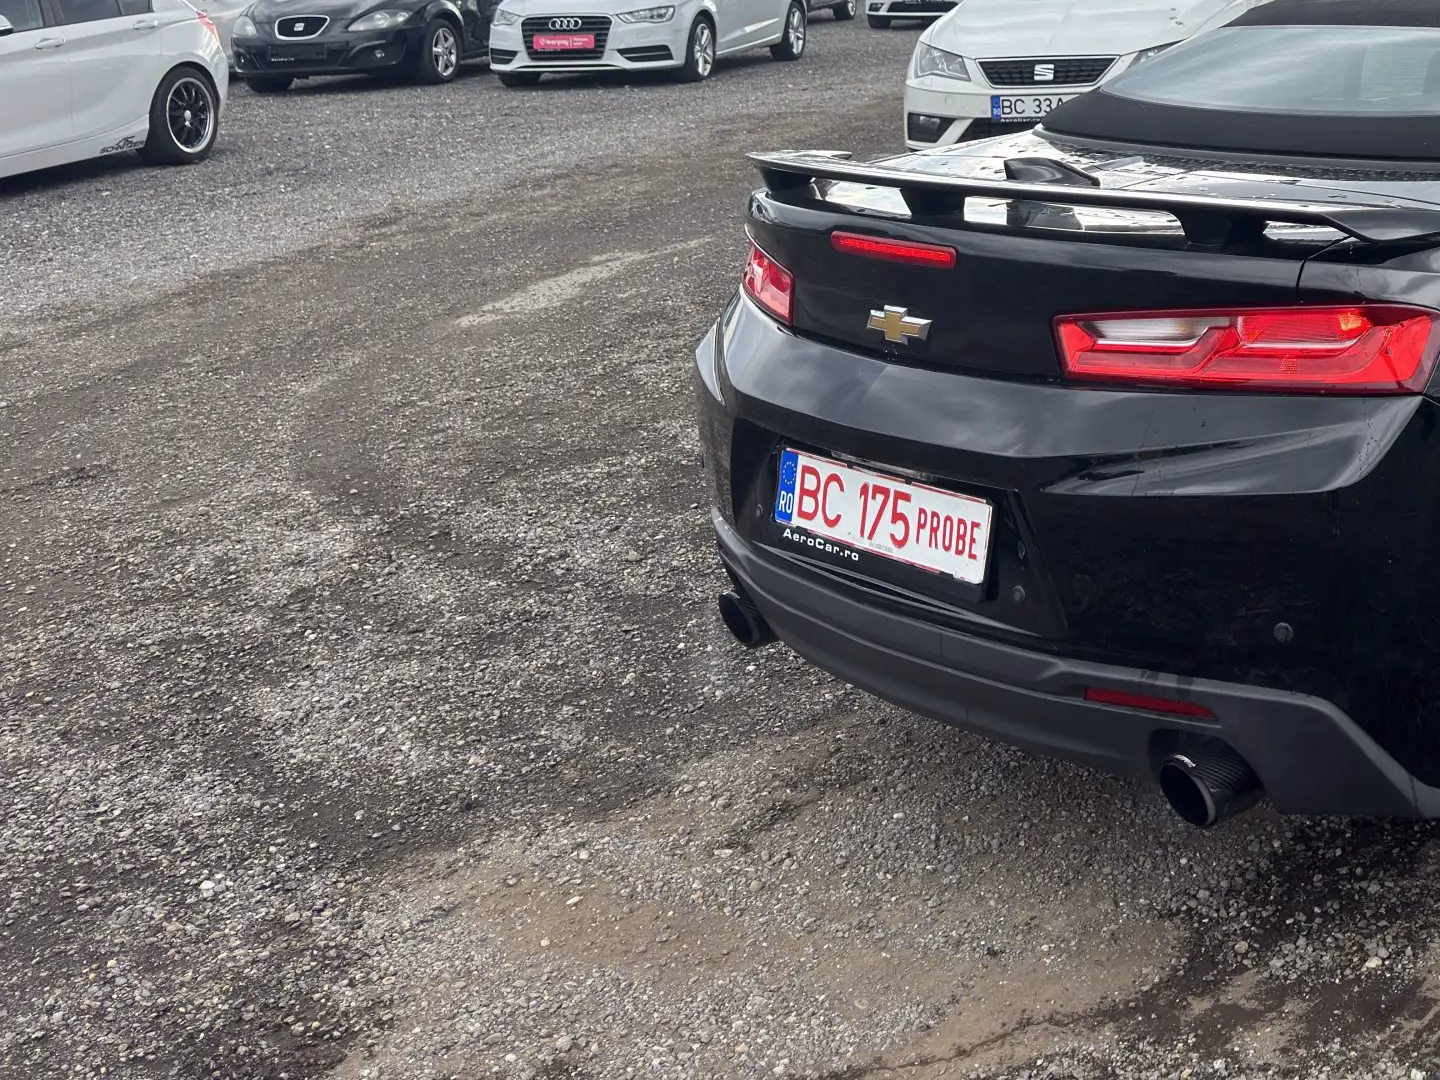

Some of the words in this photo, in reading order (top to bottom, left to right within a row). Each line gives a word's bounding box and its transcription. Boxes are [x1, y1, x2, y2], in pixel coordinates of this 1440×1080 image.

[1001, 98, 1026, 116] BC
[778, 490, 794, 514] RO
[797, 464, 845, 528] BC
[859, 481, 912, 549] 175
[916, 506, 981, 561] PROBE
[782, 528, 859, 561] AeroCar.ro
